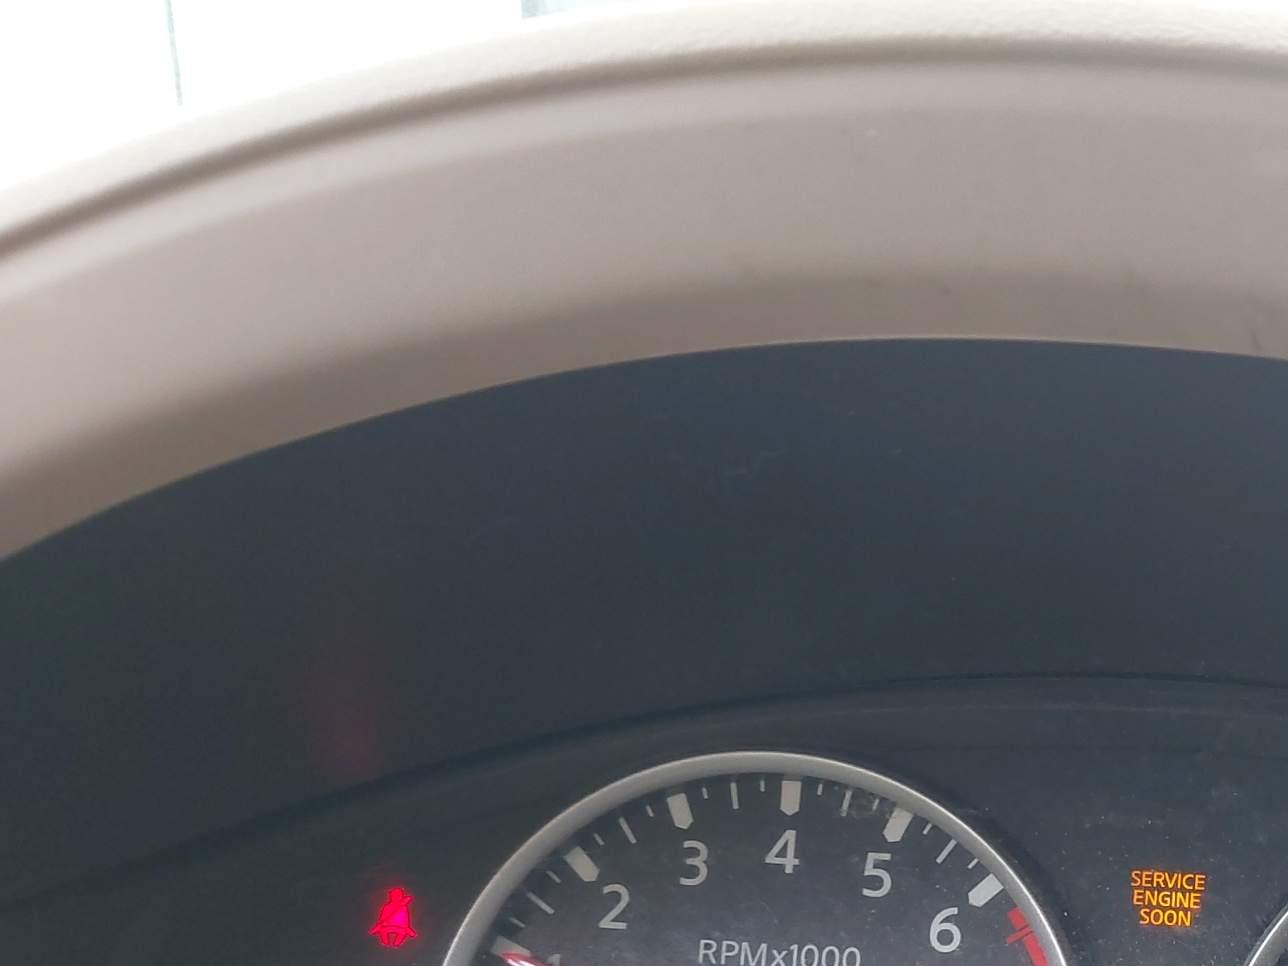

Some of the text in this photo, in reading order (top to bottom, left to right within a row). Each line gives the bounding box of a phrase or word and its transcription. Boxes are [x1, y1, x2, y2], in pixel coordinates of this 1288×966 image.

[679, 840, 709, 886] 3
[764, 829, 800, 874] 4
[861, 852, 893, 899] 5
[1130, 870, 1206, 890] SERVICE
[598, 883, 630, 930] 2
[1133, 889, 1201, 909] ENGINE
[1139, 908, 1191, 927] SOON
[928, 907, 962, 953] 6
